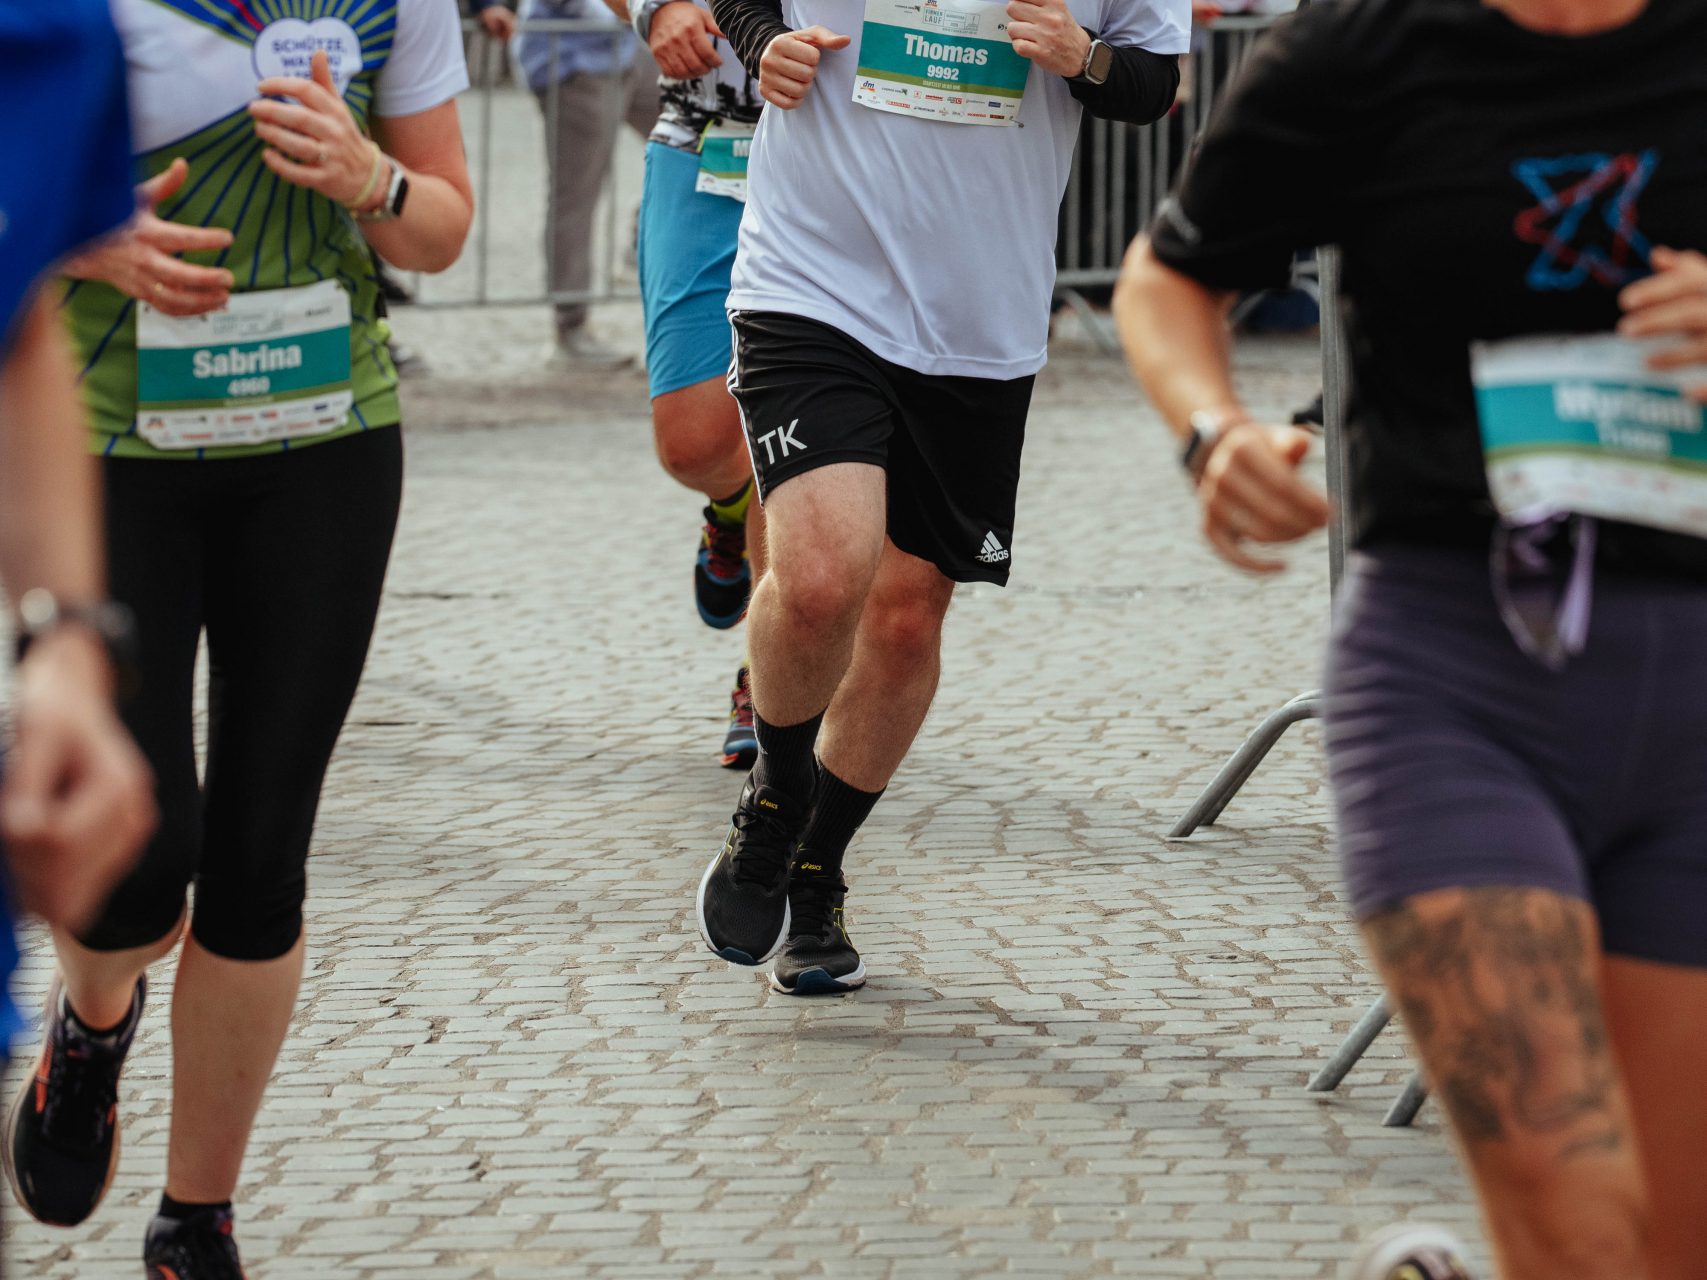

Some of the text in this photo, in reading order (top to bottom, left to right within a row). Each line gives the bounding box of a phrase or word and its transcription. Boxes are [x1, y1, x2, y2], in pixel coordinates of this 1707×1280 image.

[924, 16, 942, 24] LAUF
[904, 32, 989, 66] Thomas
[926, 64, 960, 81] 9992
[732, 139, 752, 157] M
[191, 342, 303, 379] Sabrina
[757, 418, 808, 465] TK
[975, 549, 1009, 563] adidas
